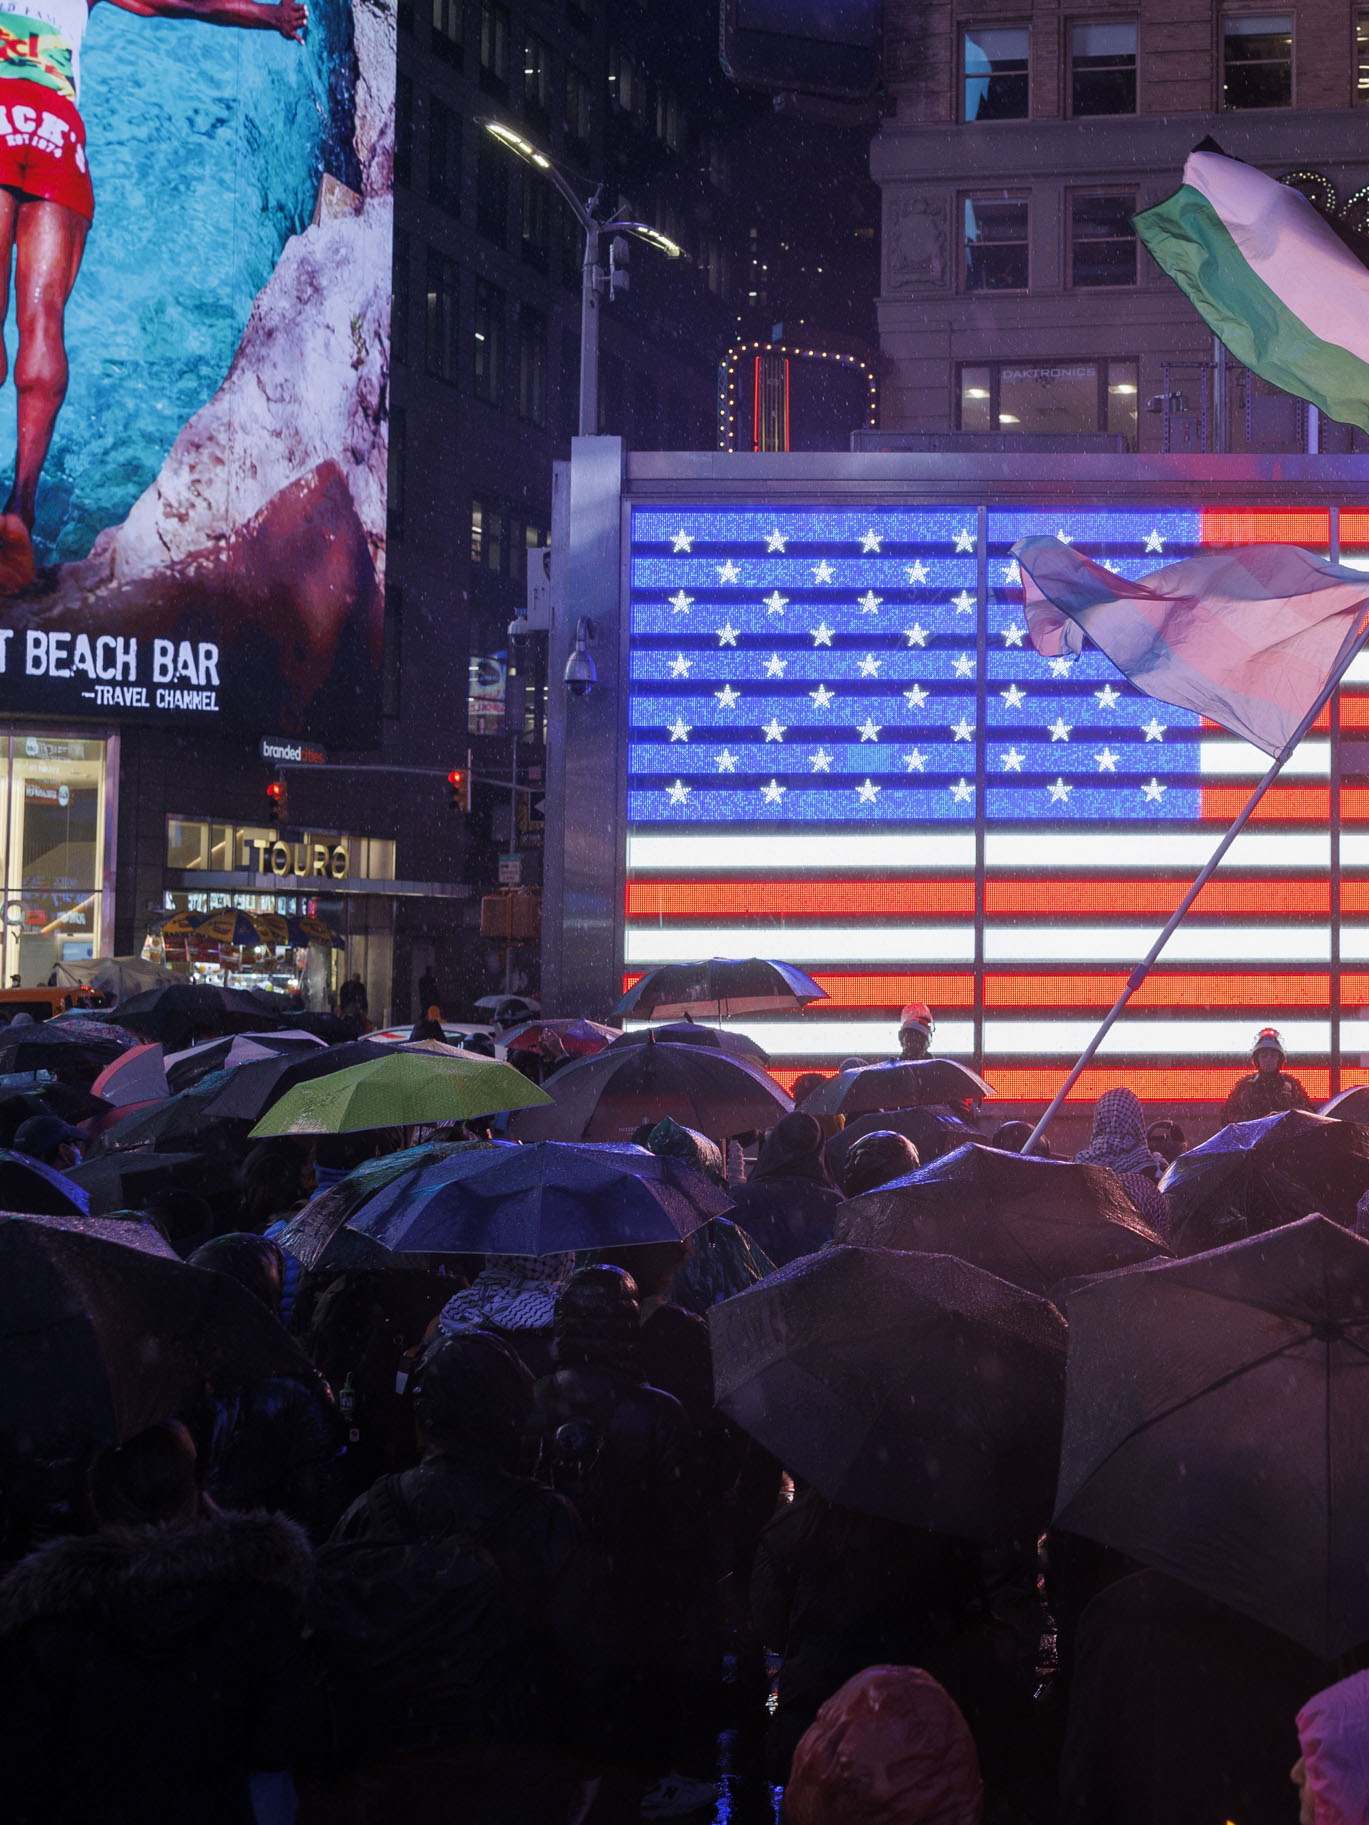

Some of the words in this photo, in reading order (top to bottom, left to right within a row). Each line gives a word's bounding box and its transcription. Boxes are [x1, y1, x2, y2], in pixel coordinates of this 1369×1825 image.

[1002, 368, 1097, 379] DAKTRONICS
[25, 630, 138, 681] BEACH
[152, 638, 221, 686] BAR
[155, 688, 220, 712] CHANNEL
[253, 839, 350, 879] TOURO
